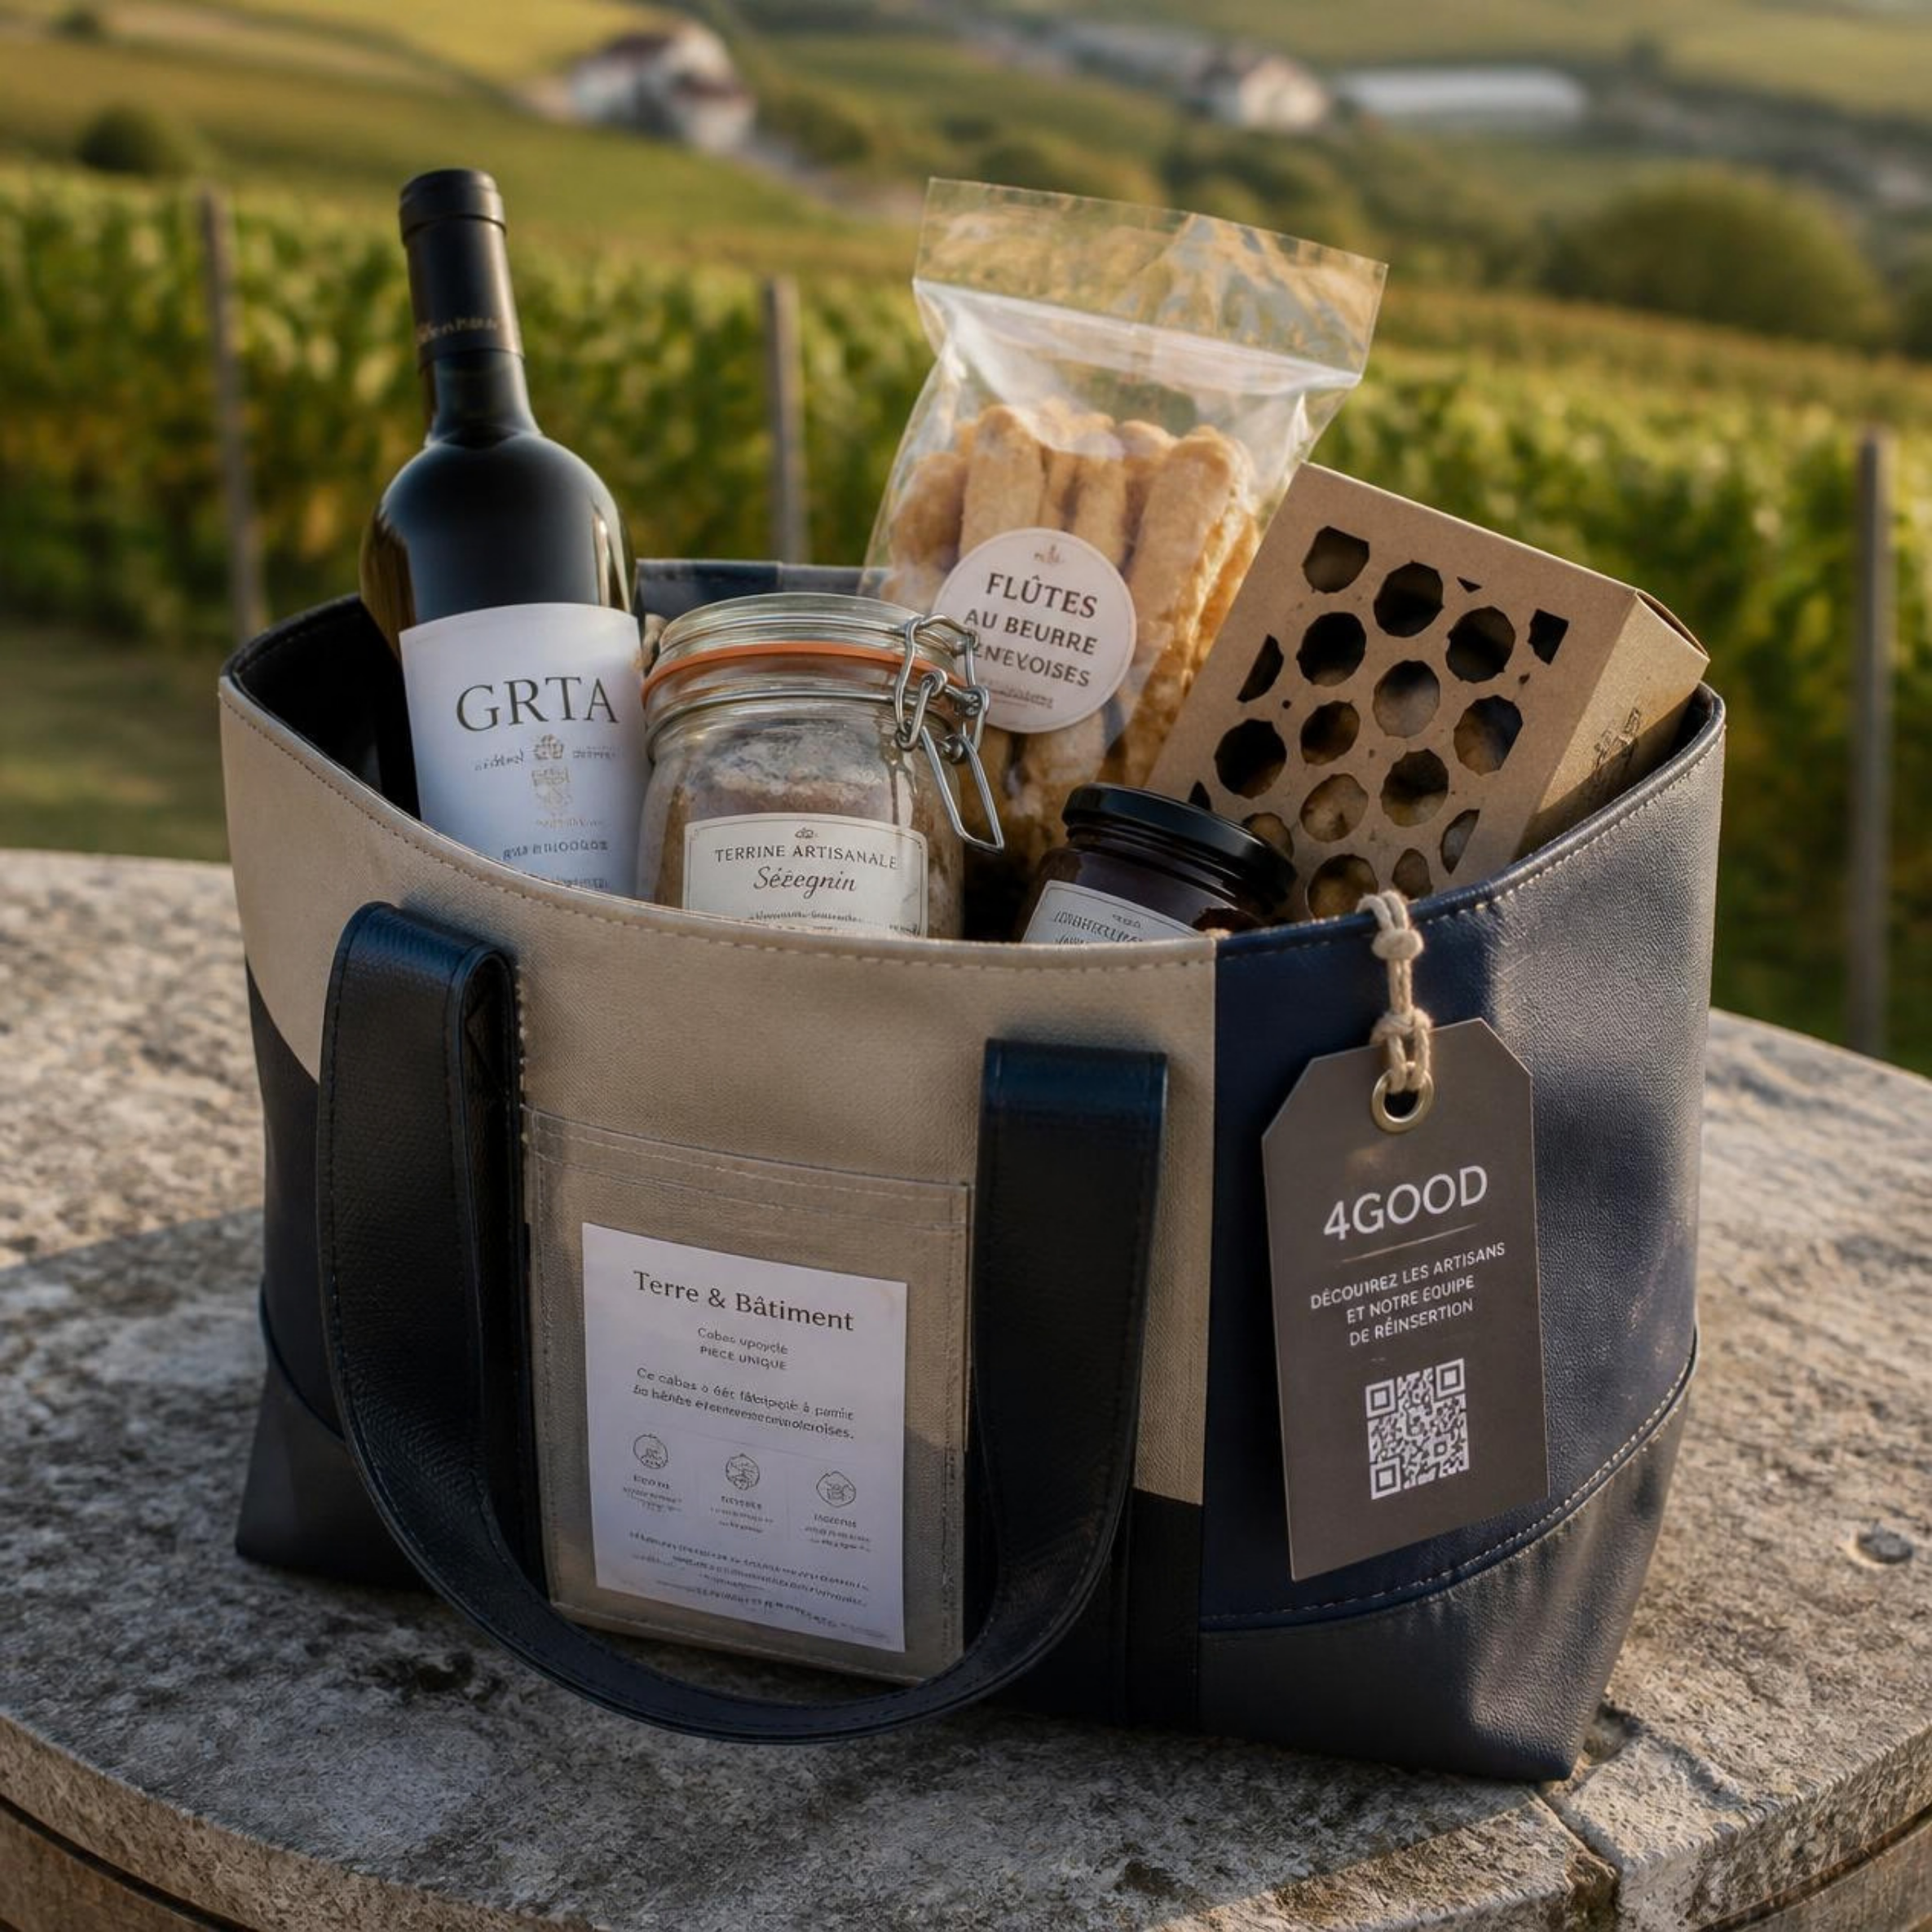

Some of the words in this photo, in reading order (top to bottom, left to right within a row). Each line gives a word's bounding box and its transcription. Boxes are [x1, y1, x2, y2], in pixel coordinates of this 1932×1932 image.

[986, 572, 1098, 619] FLÛTES
[964, 609, 998, 629] AU
[1003, 616, 1098, 655] BEURRE
[457, 676, 620, 732] GRTA
[715, 845, 785, 862] TERRINE
[792, 845, 898, 870] ARTISANALE
[1323, 1165, 1489, 1241] 4GOOD
[1402, 1264, 1429, 1285] LES
[1432, 1242, 1506, 1274] ARTISANS
[633, 1269, 699, 1303] Terre
[708, 1287, 726, 1309] &
[735, 1292, 855, 1331] Bâtiment
[1346, 1306, 1365, 1325] ET
[1370, 1289, 1419, 1318] NOTRE
[1349, 1327, 1370, 1346] DE
[1374, 1298, 1474, 1340] RÉINSERTION
